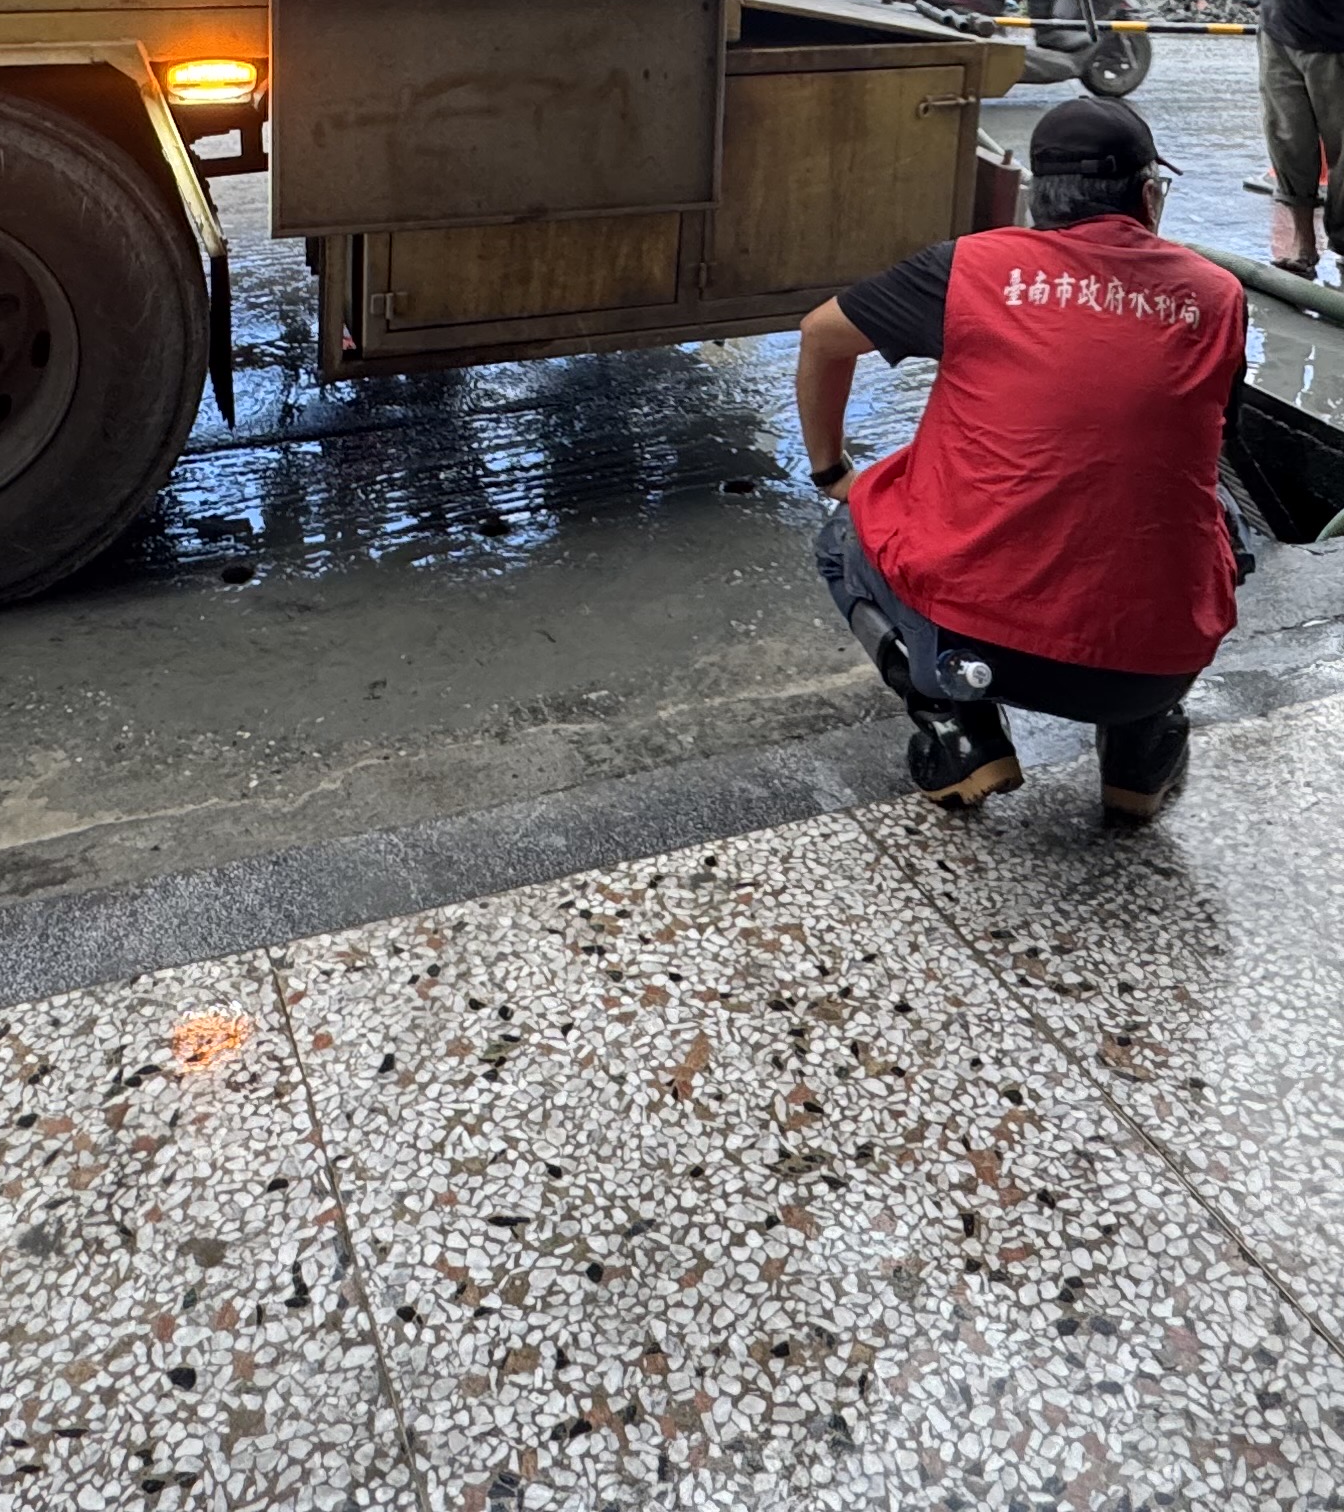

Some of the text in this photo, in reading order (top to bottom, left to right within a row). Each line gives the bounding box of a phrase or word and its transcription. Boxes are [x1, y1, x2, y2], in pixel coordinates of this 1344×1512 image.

[1004, 268, 1200, 330] 臺南市政府水利局
